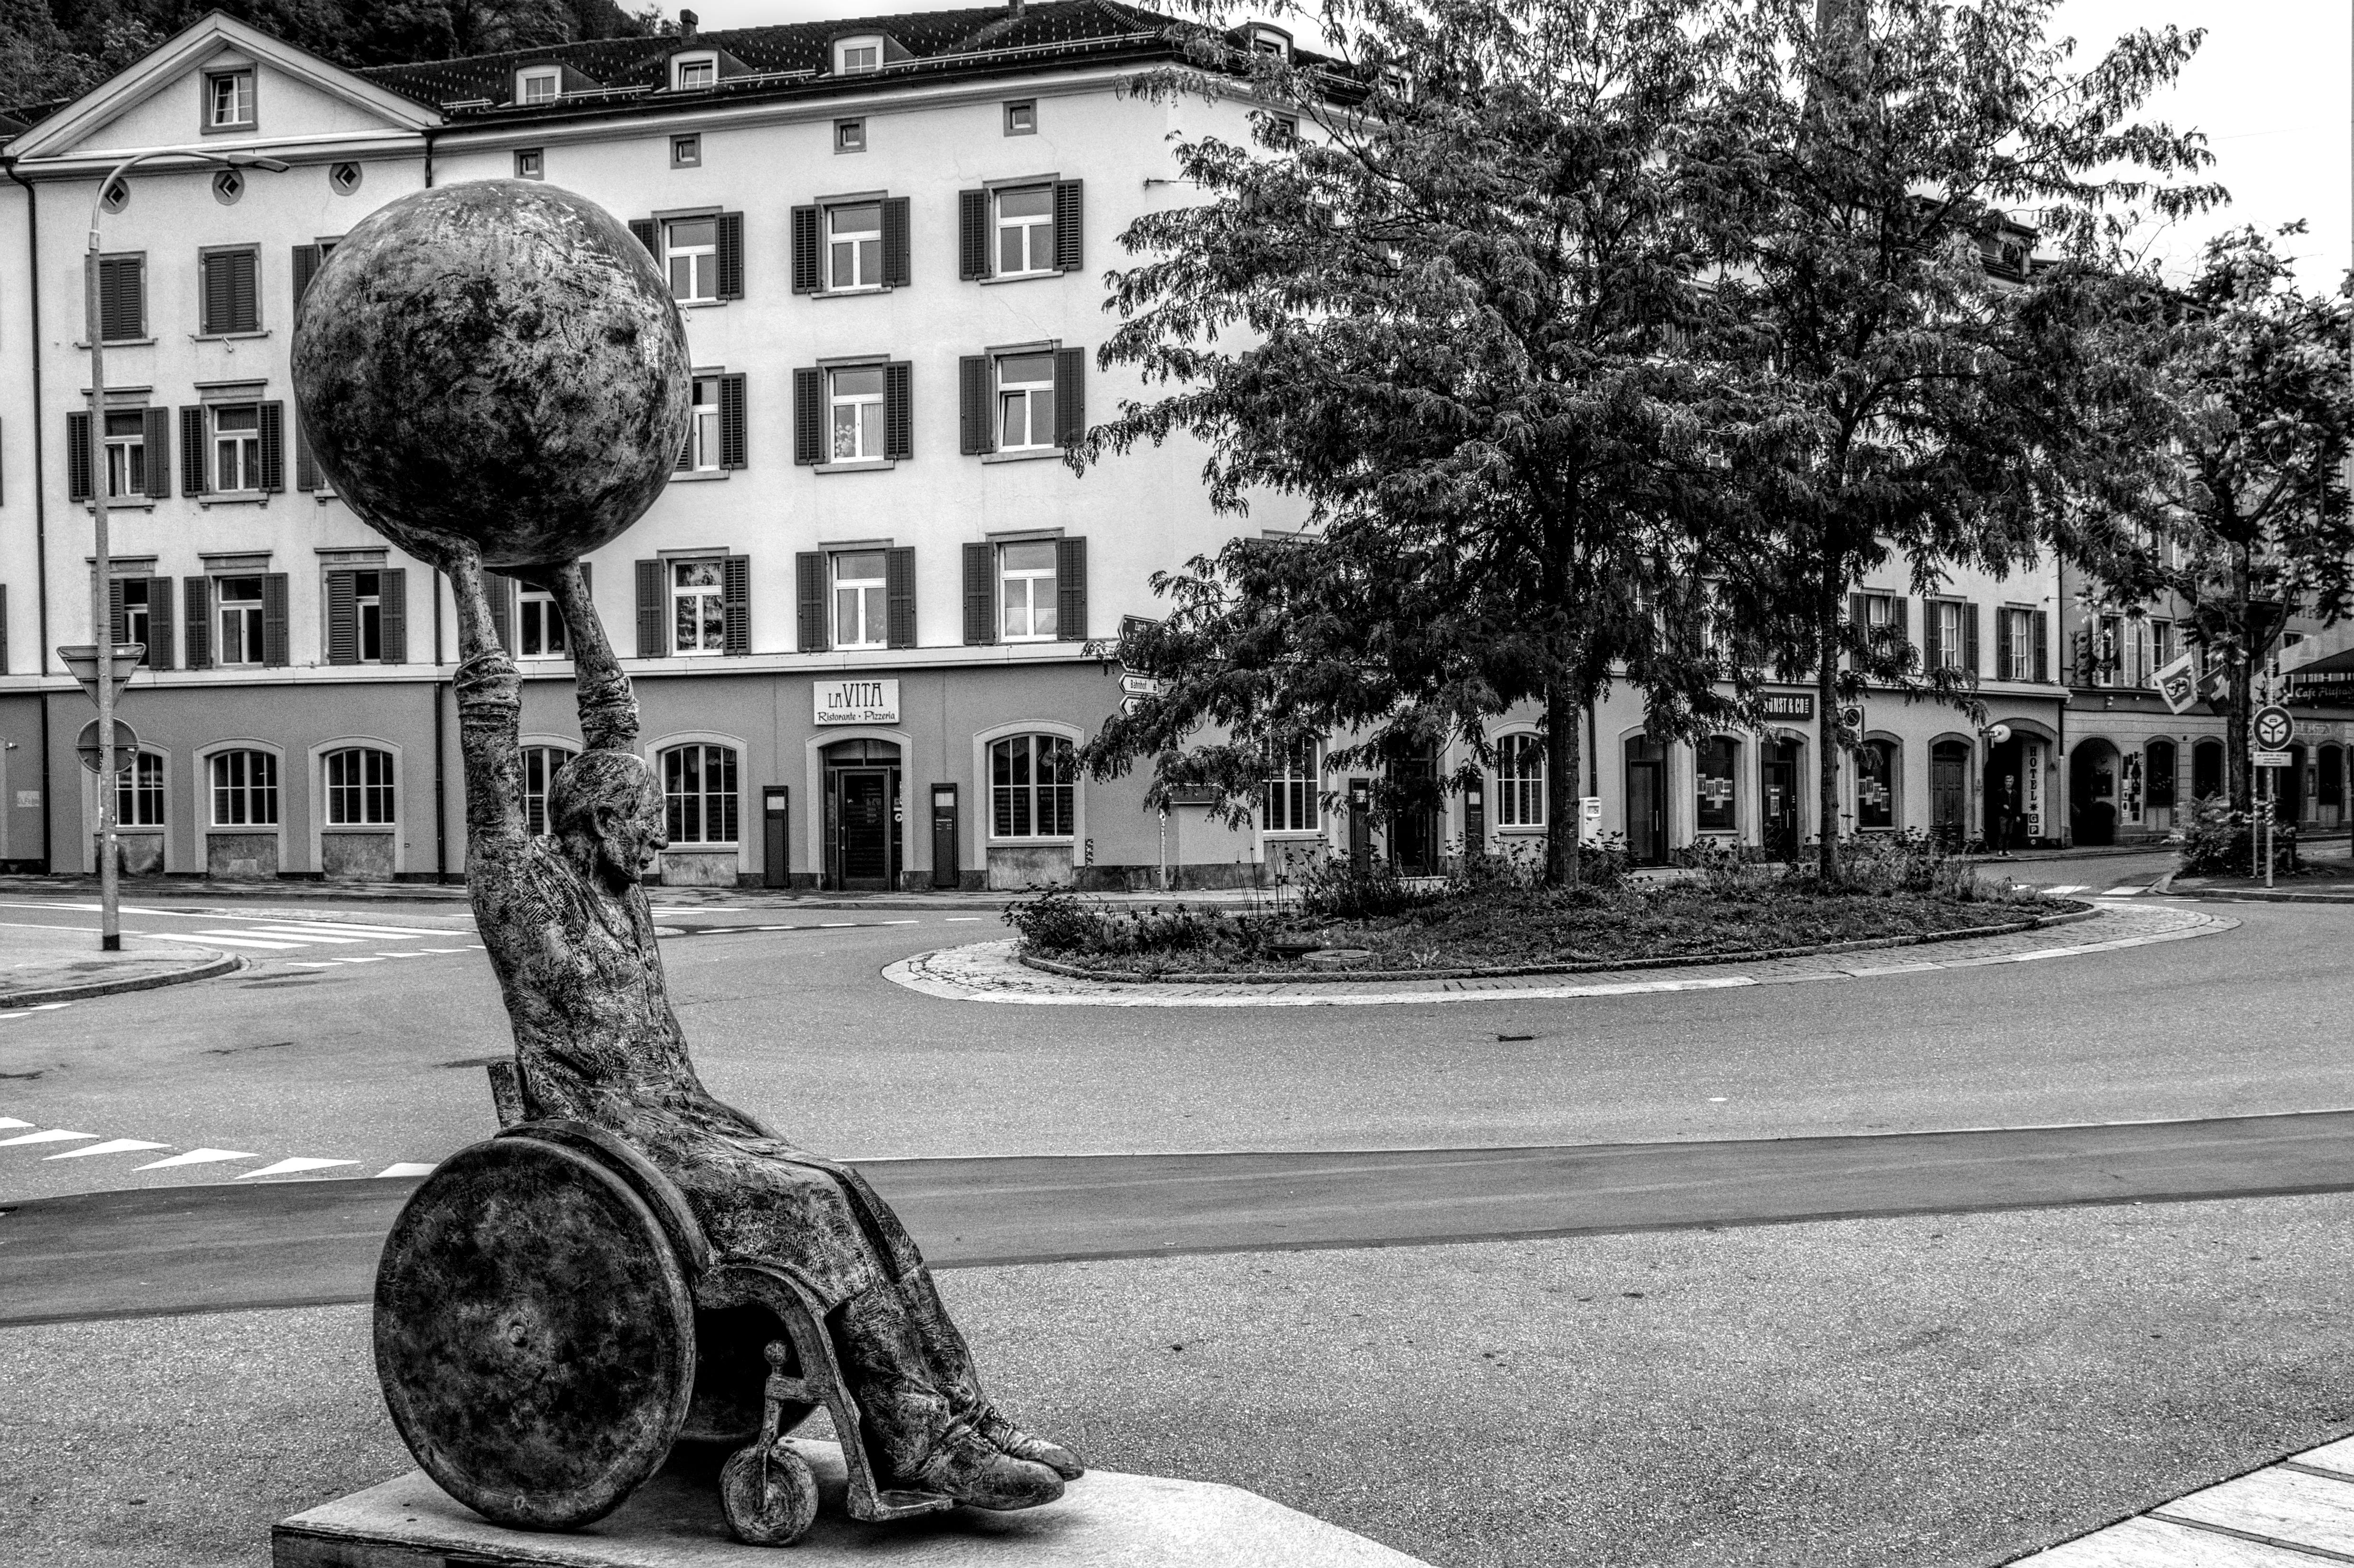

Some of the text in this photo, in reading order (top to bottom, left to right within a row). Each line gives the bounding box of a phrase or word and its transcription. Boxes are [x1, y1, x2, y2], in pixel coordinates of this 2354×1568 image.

[1131, 679, 1146, 690] Bahnhof
[828, 683, 883, 708] LA VITA
[1788, 698, 1793, 713] &
[1795, 698, 1804, 713] CO
[817, 711, 895, 721] Ristorante Pizzeria
